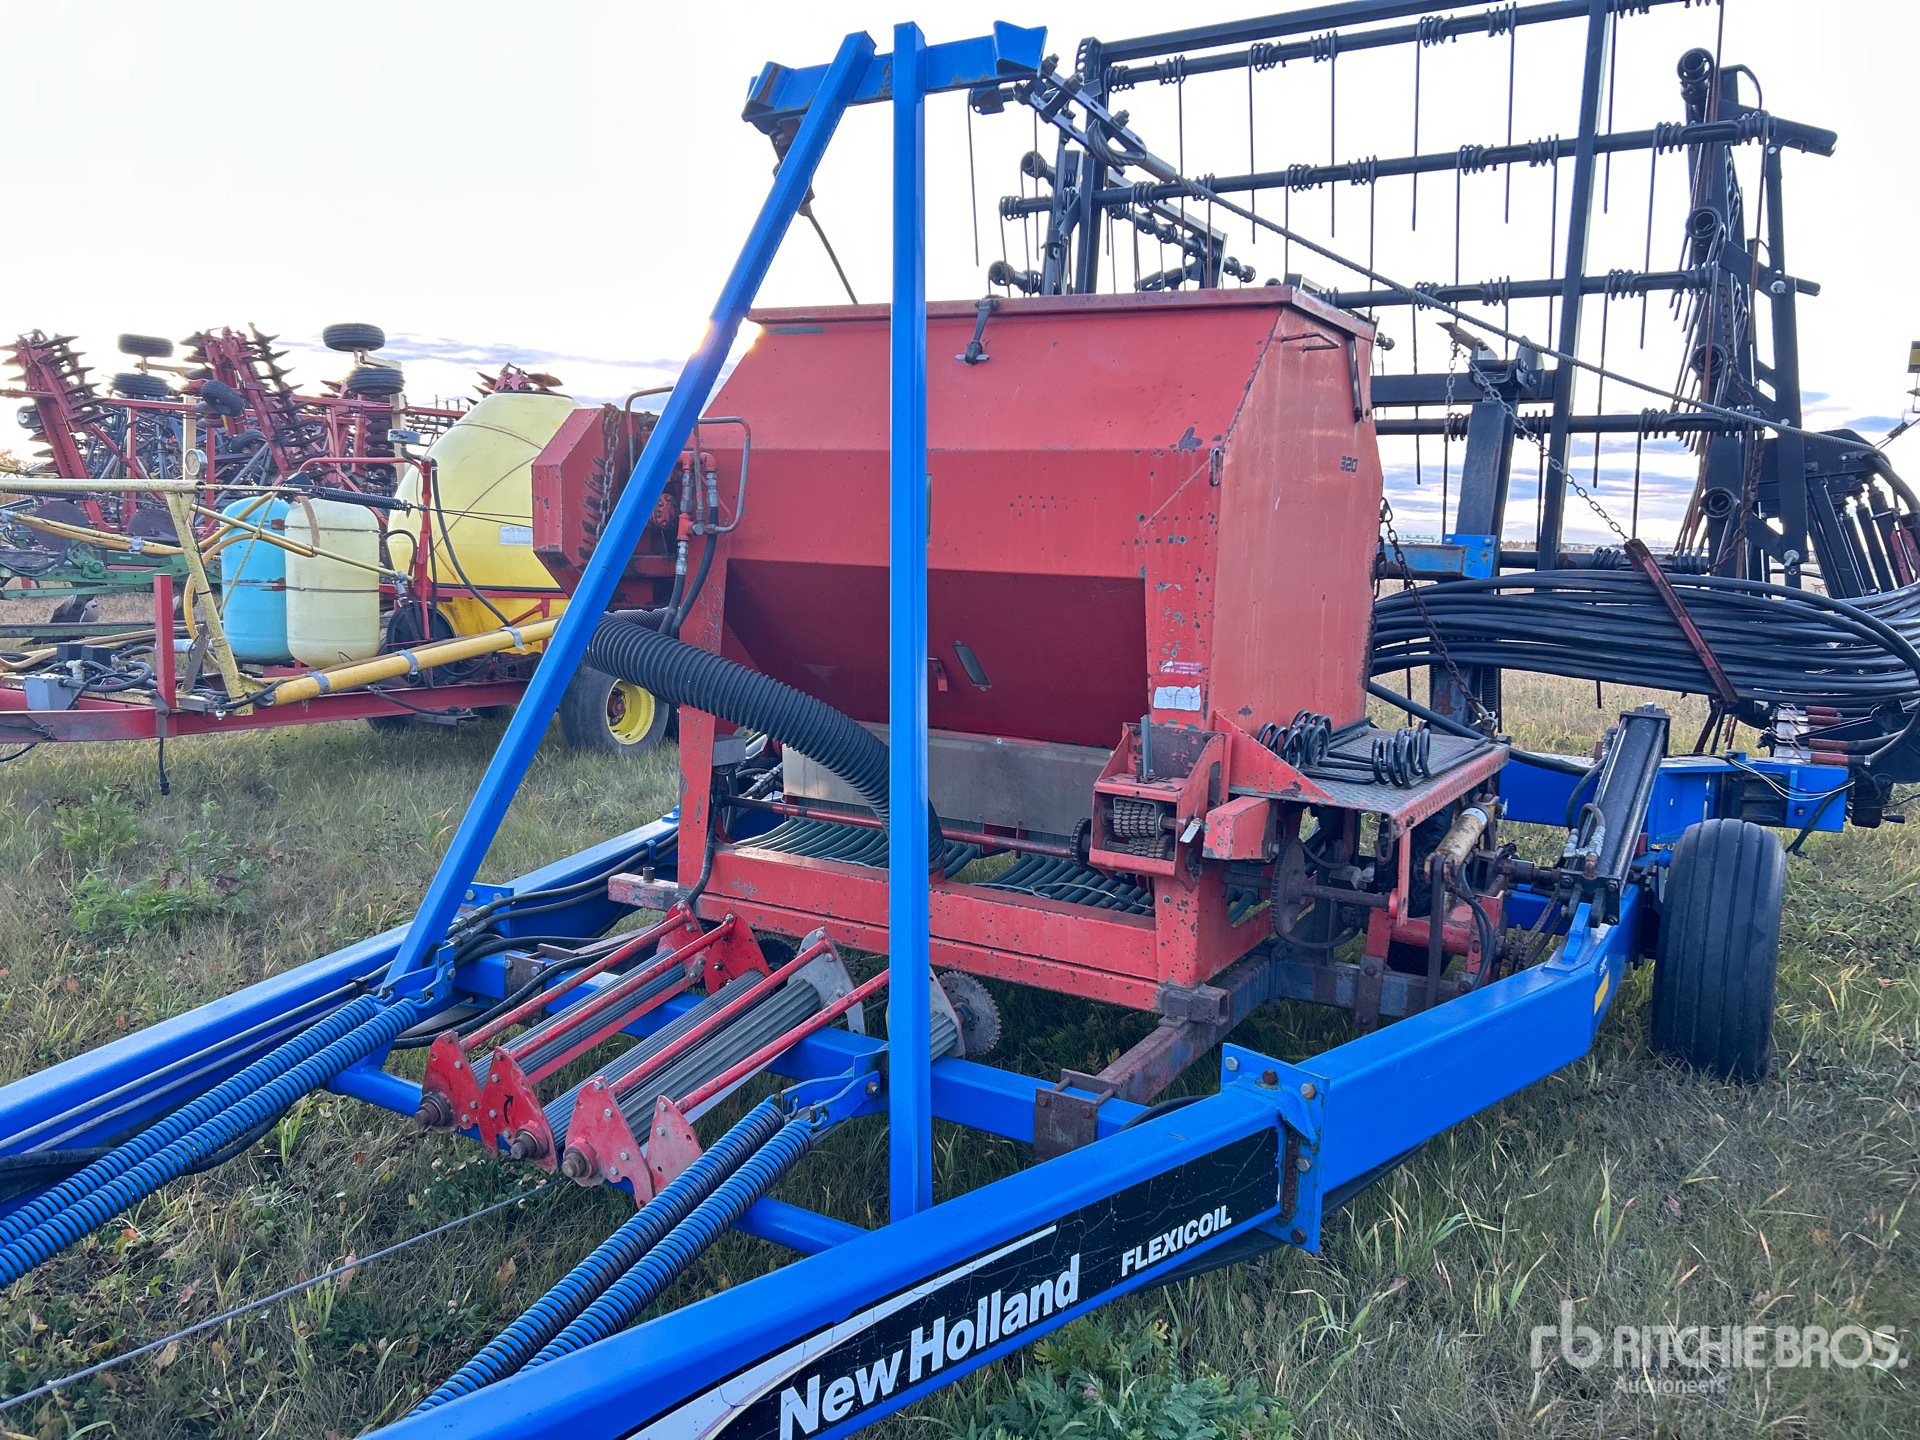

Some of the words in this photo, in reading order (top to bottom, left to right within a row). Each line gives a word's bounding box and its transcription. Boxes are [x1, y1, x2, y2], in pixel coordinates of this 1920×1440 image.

[1339, 455, 1359, 473] 320
[1121, 1204, 1232, 1277] FLEXICOIL
[779, 1349, 904, 1440] New
[909, 1252, 1080, 1383] Holland
